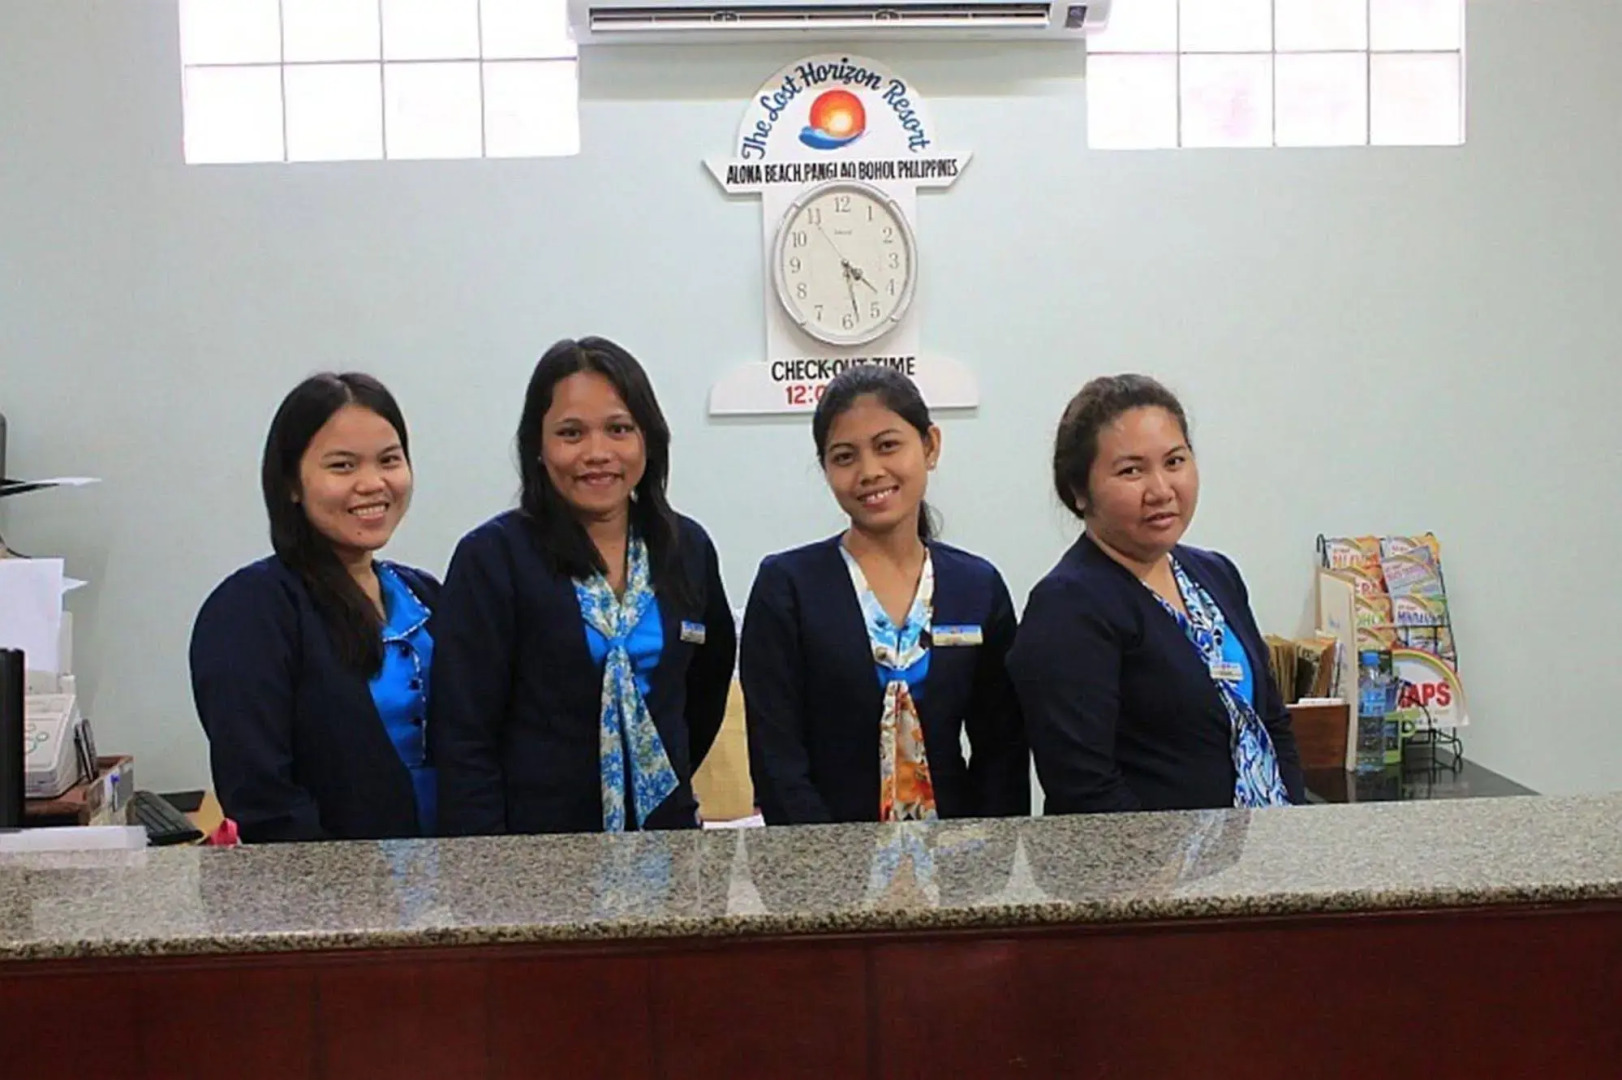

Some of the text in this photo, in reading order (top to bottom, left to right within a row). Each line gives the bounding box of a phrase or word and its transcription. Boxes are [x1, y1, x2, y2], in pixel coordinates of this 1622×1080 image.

[741, 57, 931, 160] The Lost Horizon Resort
[726, 164, 763, 184] ALONA
[859, 160, 896, 180] BOHOL
[834, 196, 851, 213] 12
[867, 205, 874, 222] 1
[791, 231, 808, 248] 10
[882, 227, 894, 244] 2
[789, 256, 801, 274] 9
[888, 252, 900, 269] 3
[796, 283, 808, 299] 8
[886, 278, 896, 296] 4
[813, 304, 824, 322] 7
[869, 302, 881, 319] 5
[842, 314, 854, 330] 6
